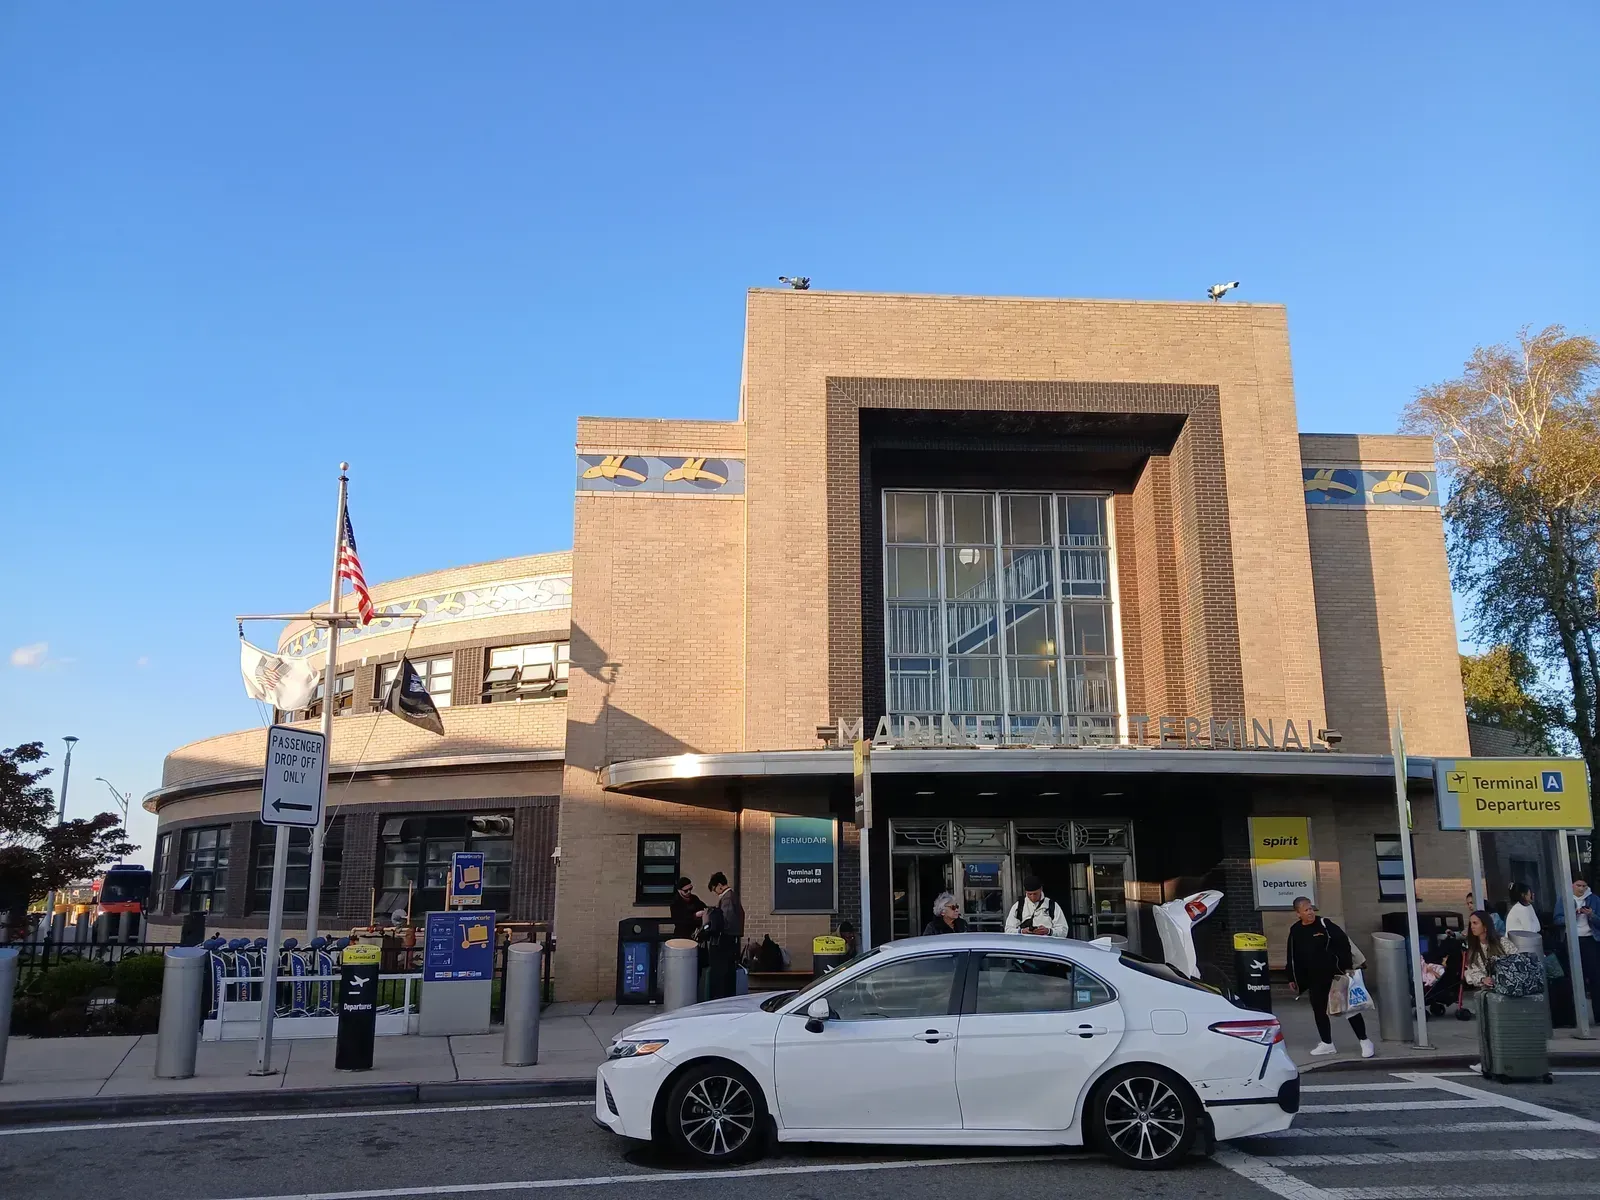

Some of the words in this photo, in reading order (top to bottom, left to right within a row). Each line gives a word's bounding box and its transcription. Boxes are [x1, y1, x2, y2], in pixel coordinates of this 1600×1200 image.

[838, 715, 996, 748] MARINE
[1032, 715, 1097, 747] AIR
[1128, 716, 1326, 751] TERMINAL
[272, 735, 322, 754] PASSENGER
[274, 752, 298, 767] DROP
[300, 756, 317, 769] OFF
[283, 770, 306, 784] ONLY
[1472, 775, 1538, 790] Terminal
[1476, 797, 1561, 815] Departures
[781, 836, 827, 844] BERMUDAIR
[1262, 836, 1300, 848] spirit
[787, 877, 822, 885] Departures
[1263, 880, 1308, 889] Departures
[343, 1003, 372, 1012] Departures
